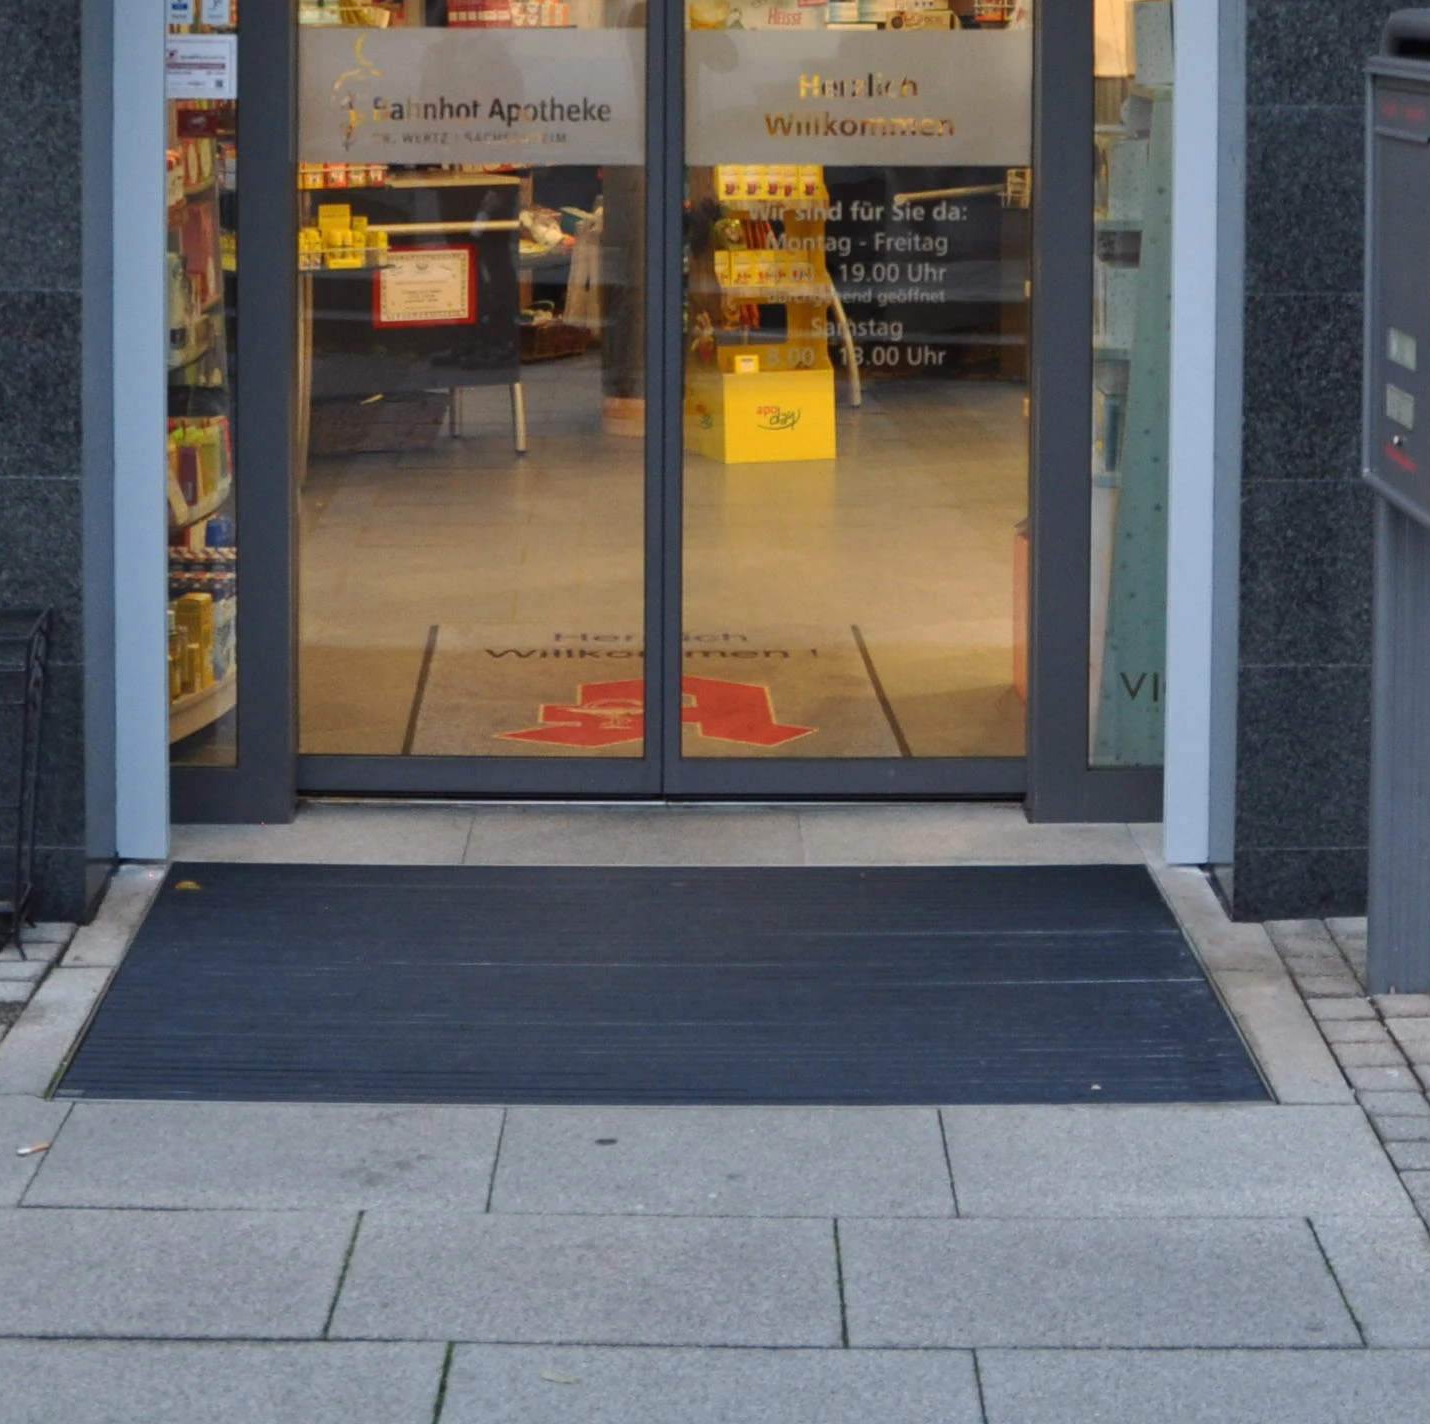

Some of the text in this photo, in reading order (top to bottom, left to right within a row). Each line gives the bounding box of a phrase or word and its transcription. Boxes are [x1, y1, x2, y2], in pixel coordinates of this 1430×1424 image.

[798, 73, 919, 99] Herzlich
[488, 97, 612, 127] Apotheke
[764, 111, 956, 138] Willkommen
[749, 200, 969, 221] Wir sind für Sie da:
[765, 232, 852, 257] Montag
[874, 231, 949, 257] Freitag
[840, 263, 900, 283] 19.00
[907, 262, 947, 283] Uhr
[877, 288, 946, 306] geöffnet
[810, 317, 904, 341] Samstag
[840, 346, 900, 366] 13.00
[907, 345, 947, 366] Uhr
